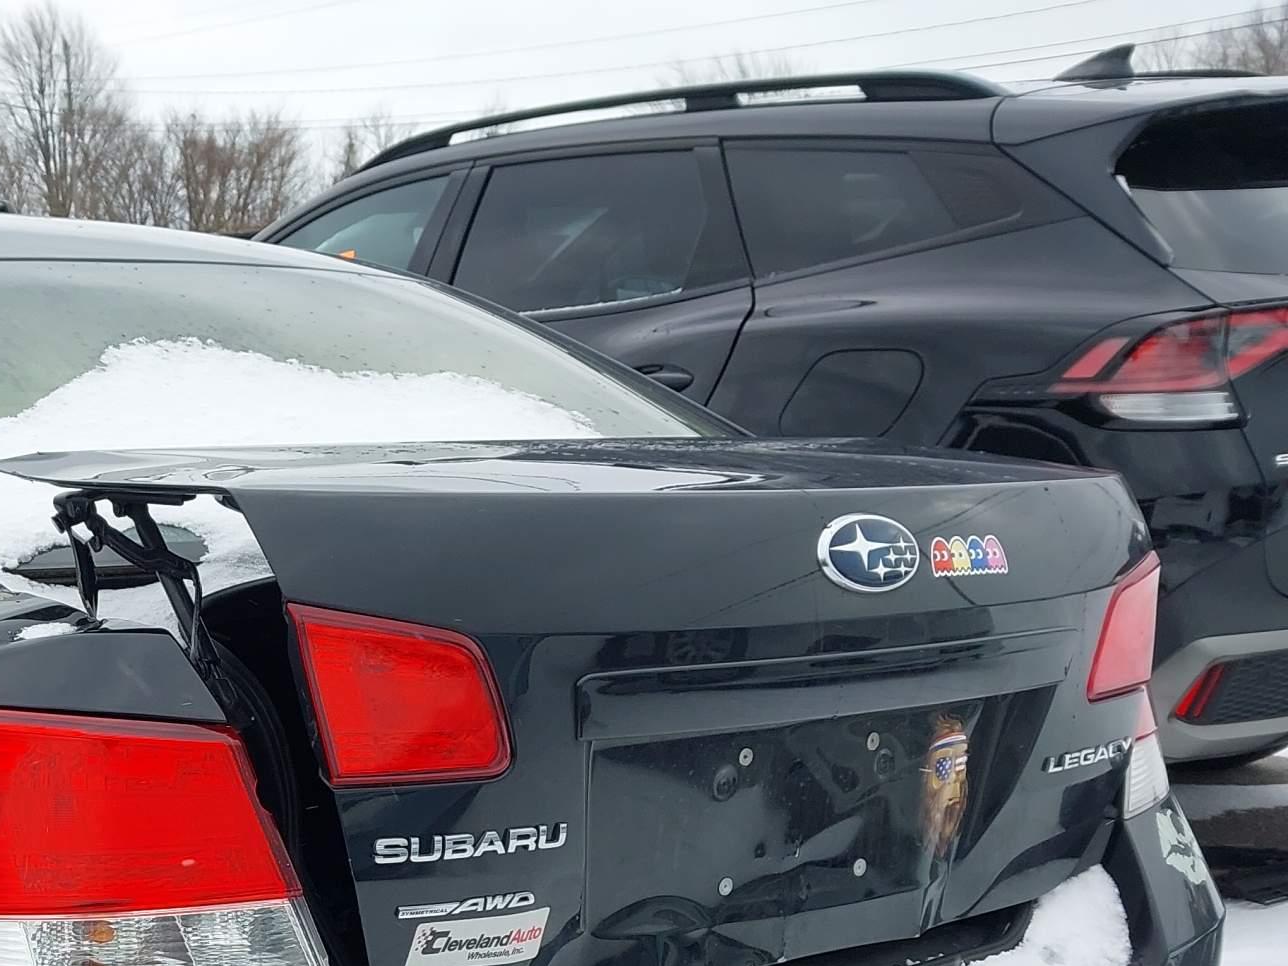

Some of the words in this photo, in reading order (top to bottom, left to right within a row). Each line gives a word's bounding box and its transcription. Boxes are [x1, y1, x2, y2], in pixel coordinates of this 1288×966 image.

[1046, 737, 1132, 773] LEGACY
[373, 822, 568, 865] SUBARU
[451, 891, 535, 915] AWD
